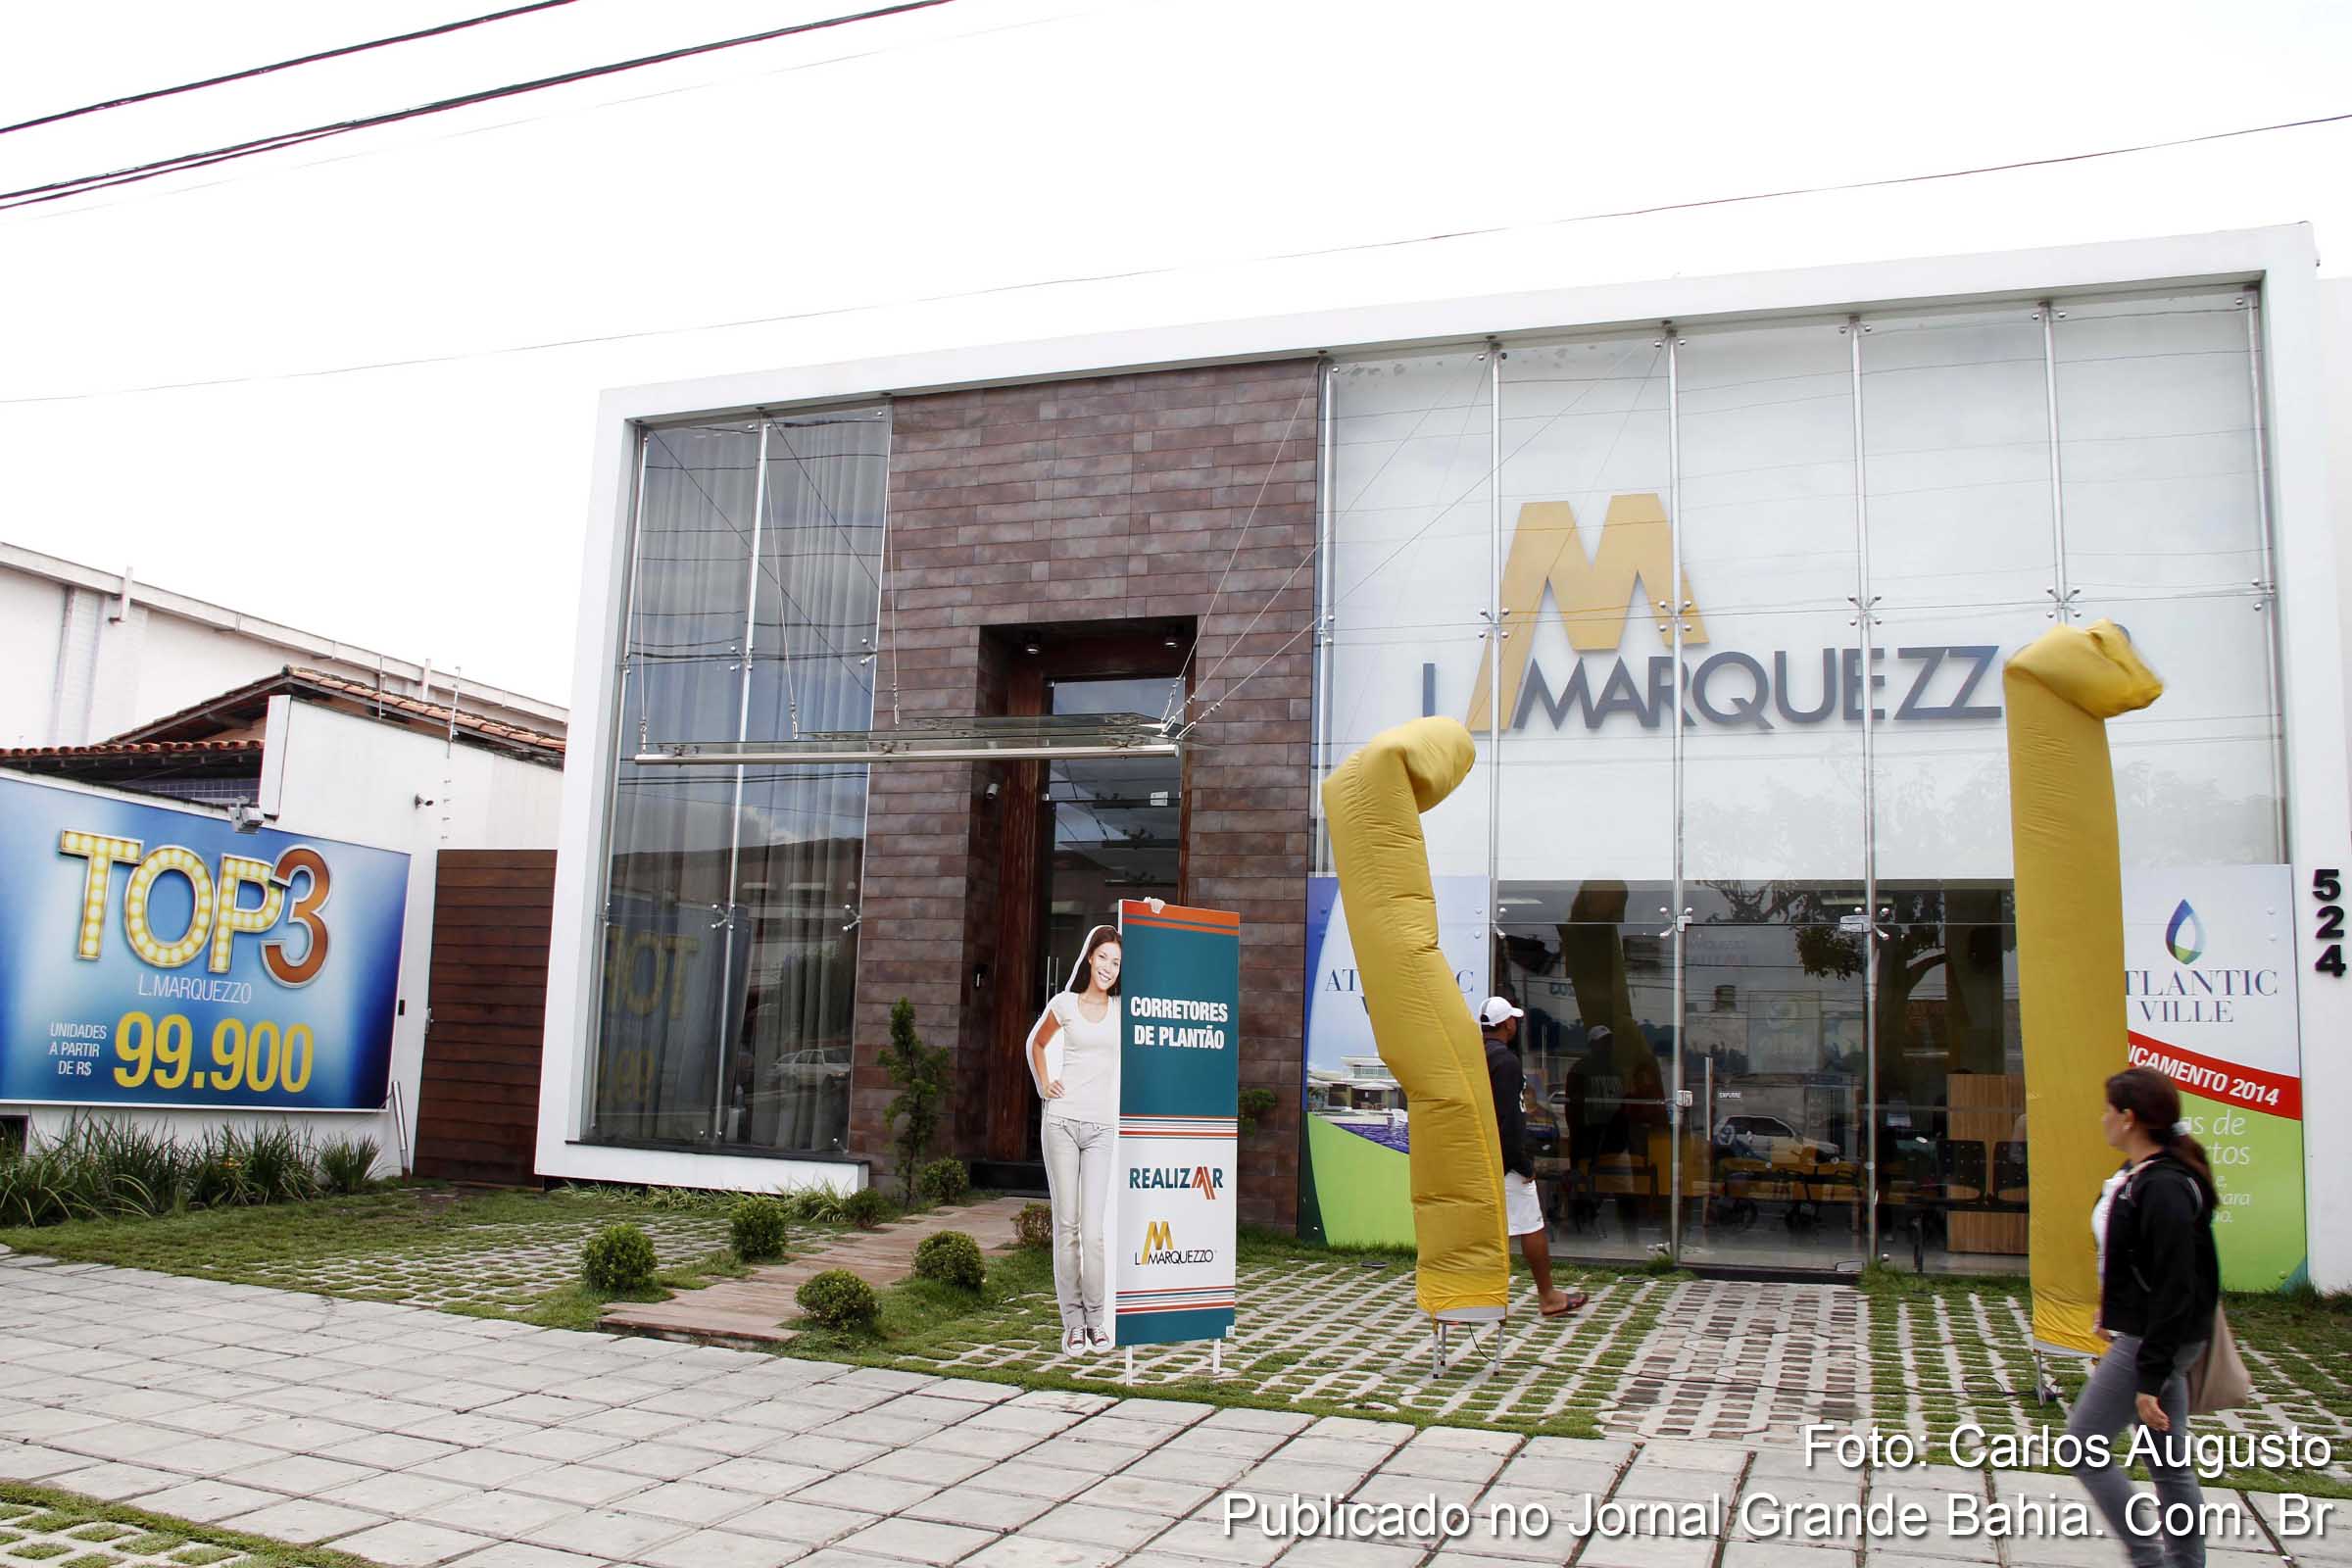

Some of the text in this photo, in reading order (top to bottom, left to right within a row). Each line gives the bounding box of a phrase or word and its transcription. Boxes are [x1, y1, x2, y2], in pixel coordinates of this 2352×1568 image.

[1513, 645, 2002, 730] MARQUEZZ
[2313, 868, 2346, 977] 524
[2125, 969, 2278, 997] TLANTIC
[1130, 996, 1228, 1022] CORRETORES
[2138, 1000, 2234, 1022] VILLE
[50, 1022, 107, 1040] UNIDADES
[1134, 1024, 1225, 1050] DE PLANTÃO
[49, 1042, 100, 1057] A PARTIR
[114, 1010, 314, 1093] 99.900
[58, 1060, 92, 1076] DE R$
[2229, 1077, 2281, 1106] 2014
[2213, 1108, 2245, 1135] de
[1147, 1249, 1214, 1266] MARQUEZZO
